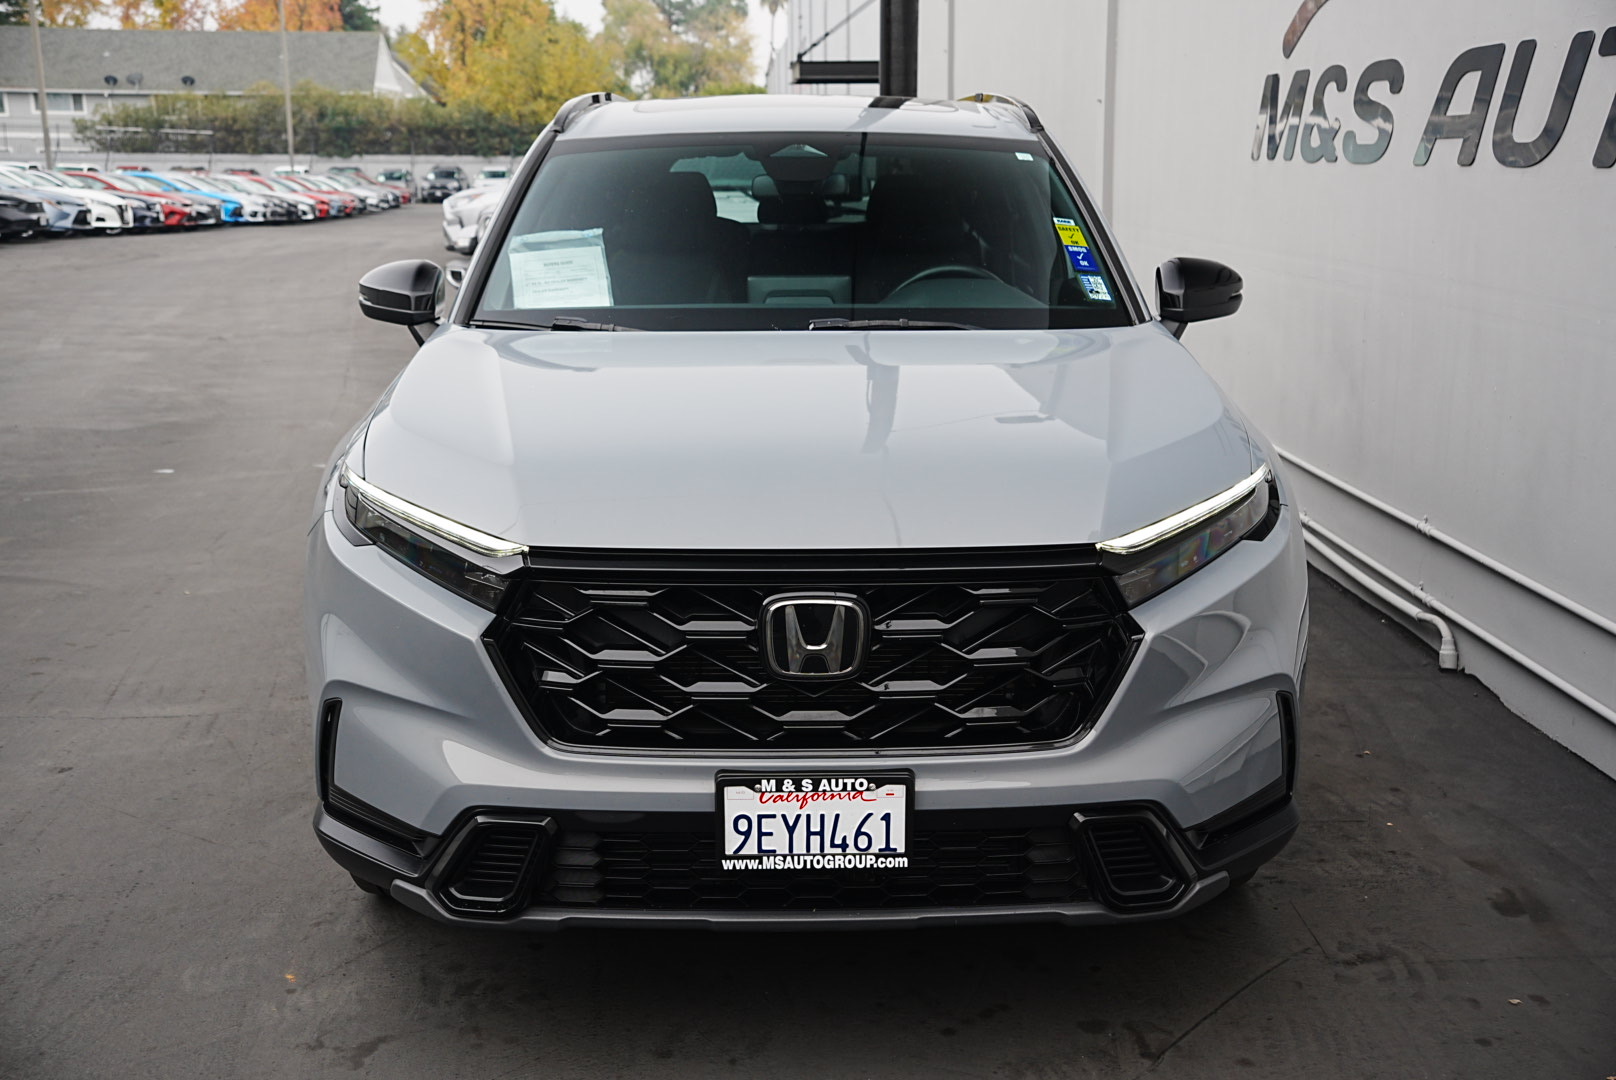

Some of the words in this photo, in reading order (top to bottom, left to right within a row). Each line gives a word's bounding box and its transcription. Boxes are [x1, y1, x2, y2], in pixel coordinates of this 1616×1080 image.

[1251, 58, 1405, 164] M&S
[761, 779, 776, 792] M
[782, 779, 796, 792] &
[801, 779, 813, 792] S
[818, 778, 868, 791] AUTO
[732, 812, 898, 855] 9EYH461
[722, 855, 908, 870] www.MSAUTOGROUP.com
